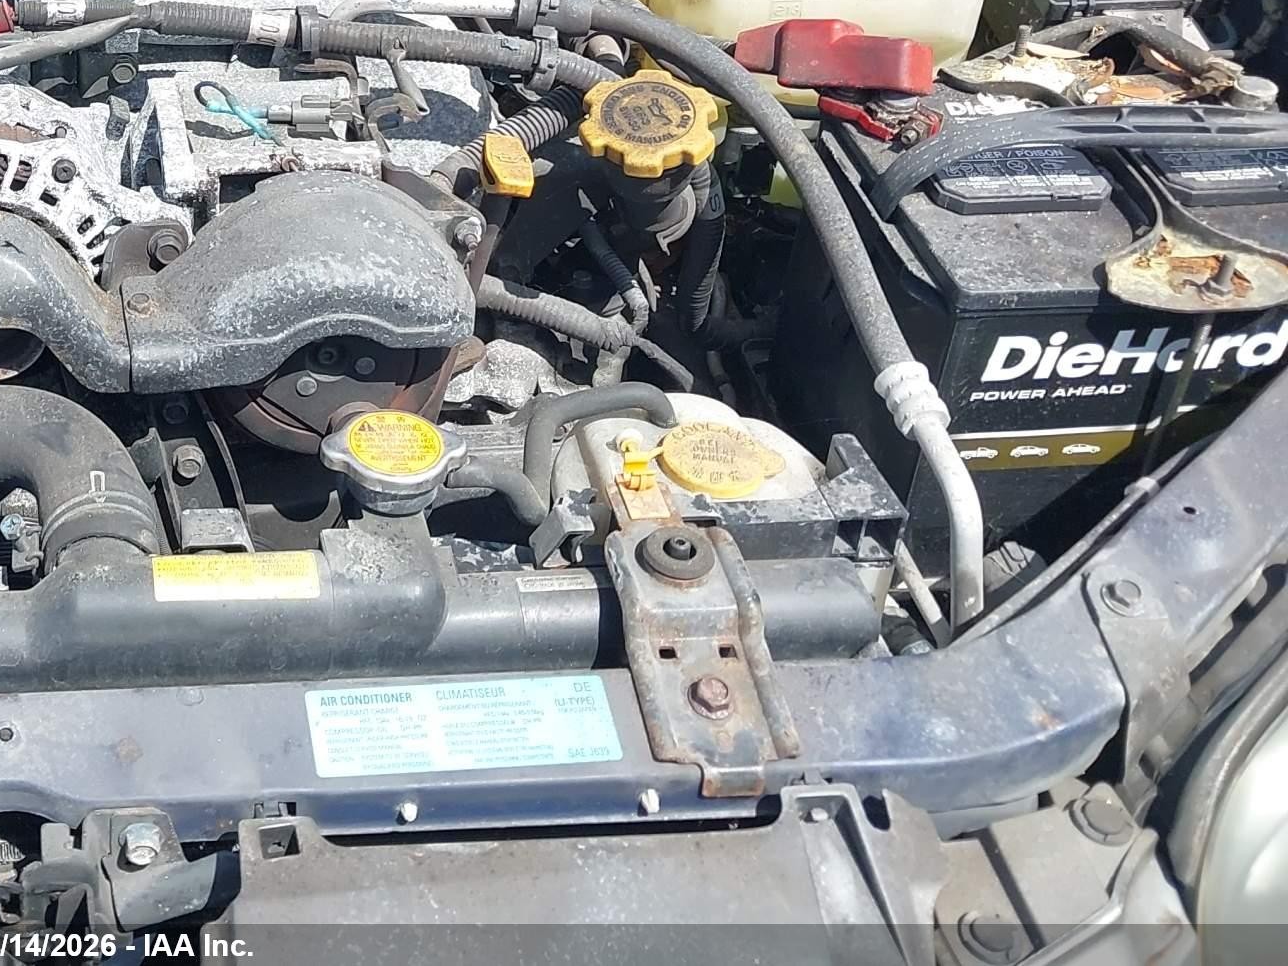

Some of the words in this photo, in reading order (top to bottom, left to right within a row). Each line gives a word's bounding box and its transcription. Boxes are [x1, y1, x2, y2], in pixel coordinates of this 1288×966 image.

[651, 85, 691, 112] ENGINE
[676, 114, 692, 129] OIL
[624, 132, 676, 145] MANUAL
[1015, 147, 1064, 158] POISON
[970, 390, 1047, 403] POWER
[377, 423, 423, 432] WARNING
[435, 686, 506, 701] CLIMATISEUR
[573, 681, 592, 693] DE
[320, 696, 337, 707] AIR
[340, 692, 413, 706] CONDITIONER
